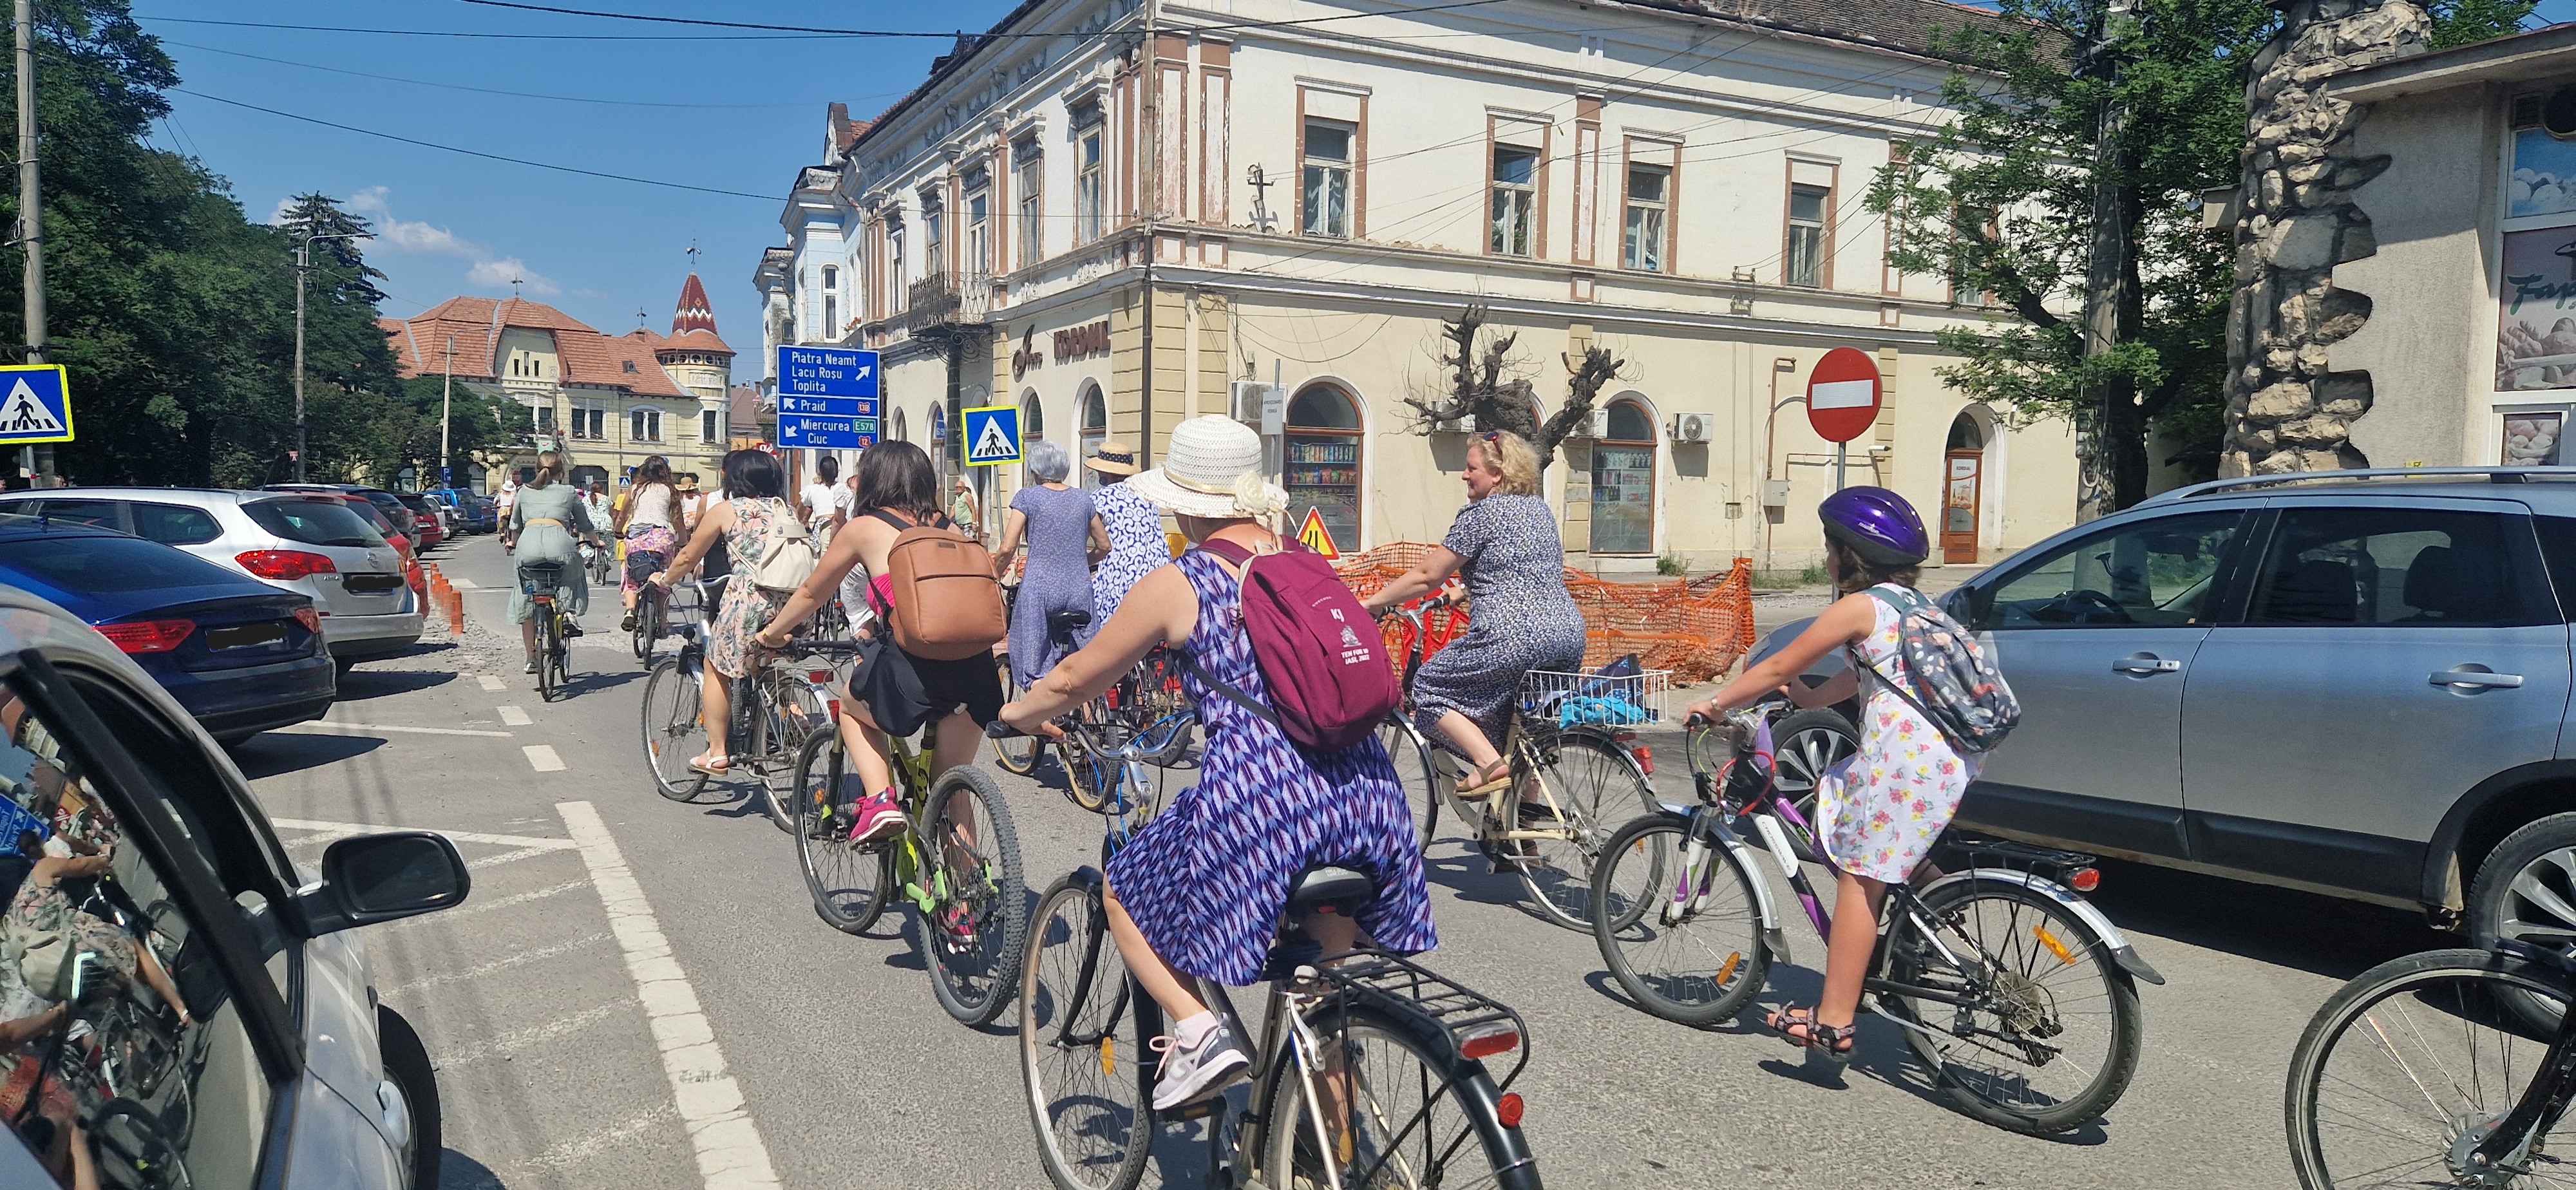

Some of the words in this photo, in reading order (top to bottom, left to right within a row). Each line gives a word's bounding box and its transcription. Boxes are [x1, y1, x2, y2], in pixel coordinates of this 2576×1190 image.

[1054, 321, 1111, 359] KORDIAL
[791, 351, 822, 364] Piatra
[825, 353, 857, 368] Neamț
[791, 365, 815, 378] Lacu
[819, 366, 842, 380] Roșu
[792, 379, 826, 393] Toplița
[800, 399, 826, 411] Praid
[858, 402, 870, 412] 13B
[800, 418, 850, 431] Miercurea
[855, 420, 875, 431] E578
[808, 433, 828, 444] Ciuc
[861, 438, 868, 446] 12
[1761, 821, 1792, 871] CROSSWAVE
